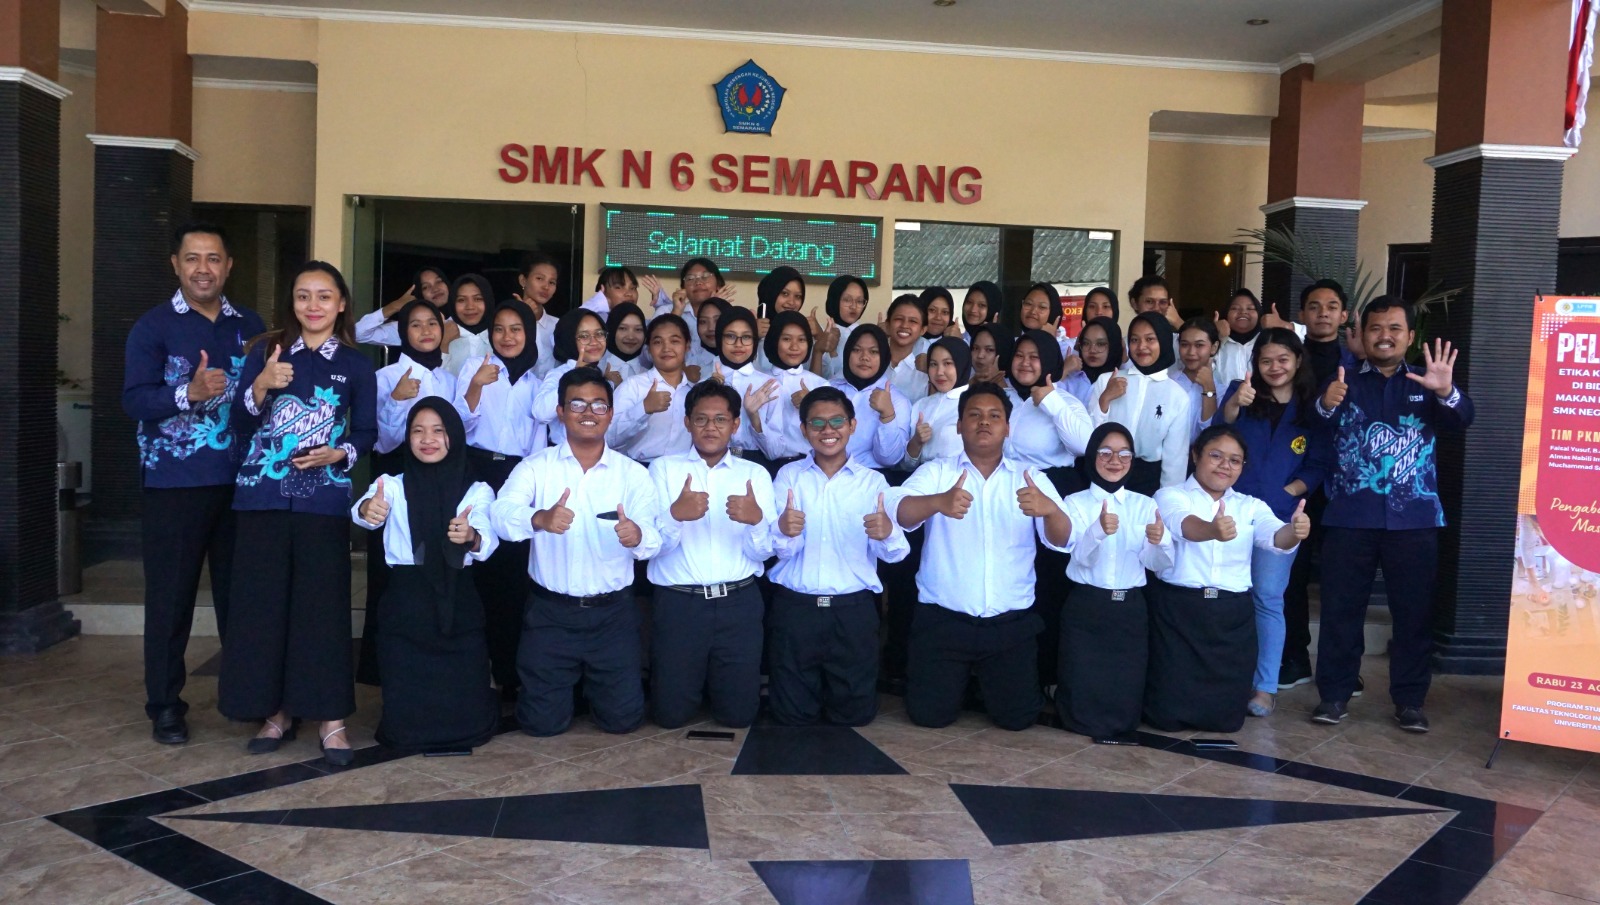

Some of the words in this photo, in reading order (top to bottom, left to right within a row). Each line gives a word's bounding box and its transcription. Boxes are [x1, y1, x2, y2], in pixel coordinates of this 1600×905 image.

[727, 72, 751, 88] MENENGAH
[752, 72, 773, 92] KEJURUAN
[498, 143, 606, 188] SMK
[622, 149, 652, 189] N
[670, 152, 694, 192] 6
[709, 153, 982, 205] SEMARANG
[648, 230, 744, 257] Selamat
[751, 235, 835, 266] Datang
[1558, 368, 1590, 376] ETIKA
[330, 374, 347, 384] USM
[1556, 394, 1596, 403] MAKAN
[1553, 407, 1576, 415] SMK
[1551, 429, 1572, 441] TIM
[1536, 676, 1566, 687] RABU
[1570, 682, 1583, 690] 23
[1546, 700, 1583, 710] PROGRAM
[1512, 704, 1549, 714] FAKULTAS
[1550, 709, 1592, 720] TEKNOLOGI
